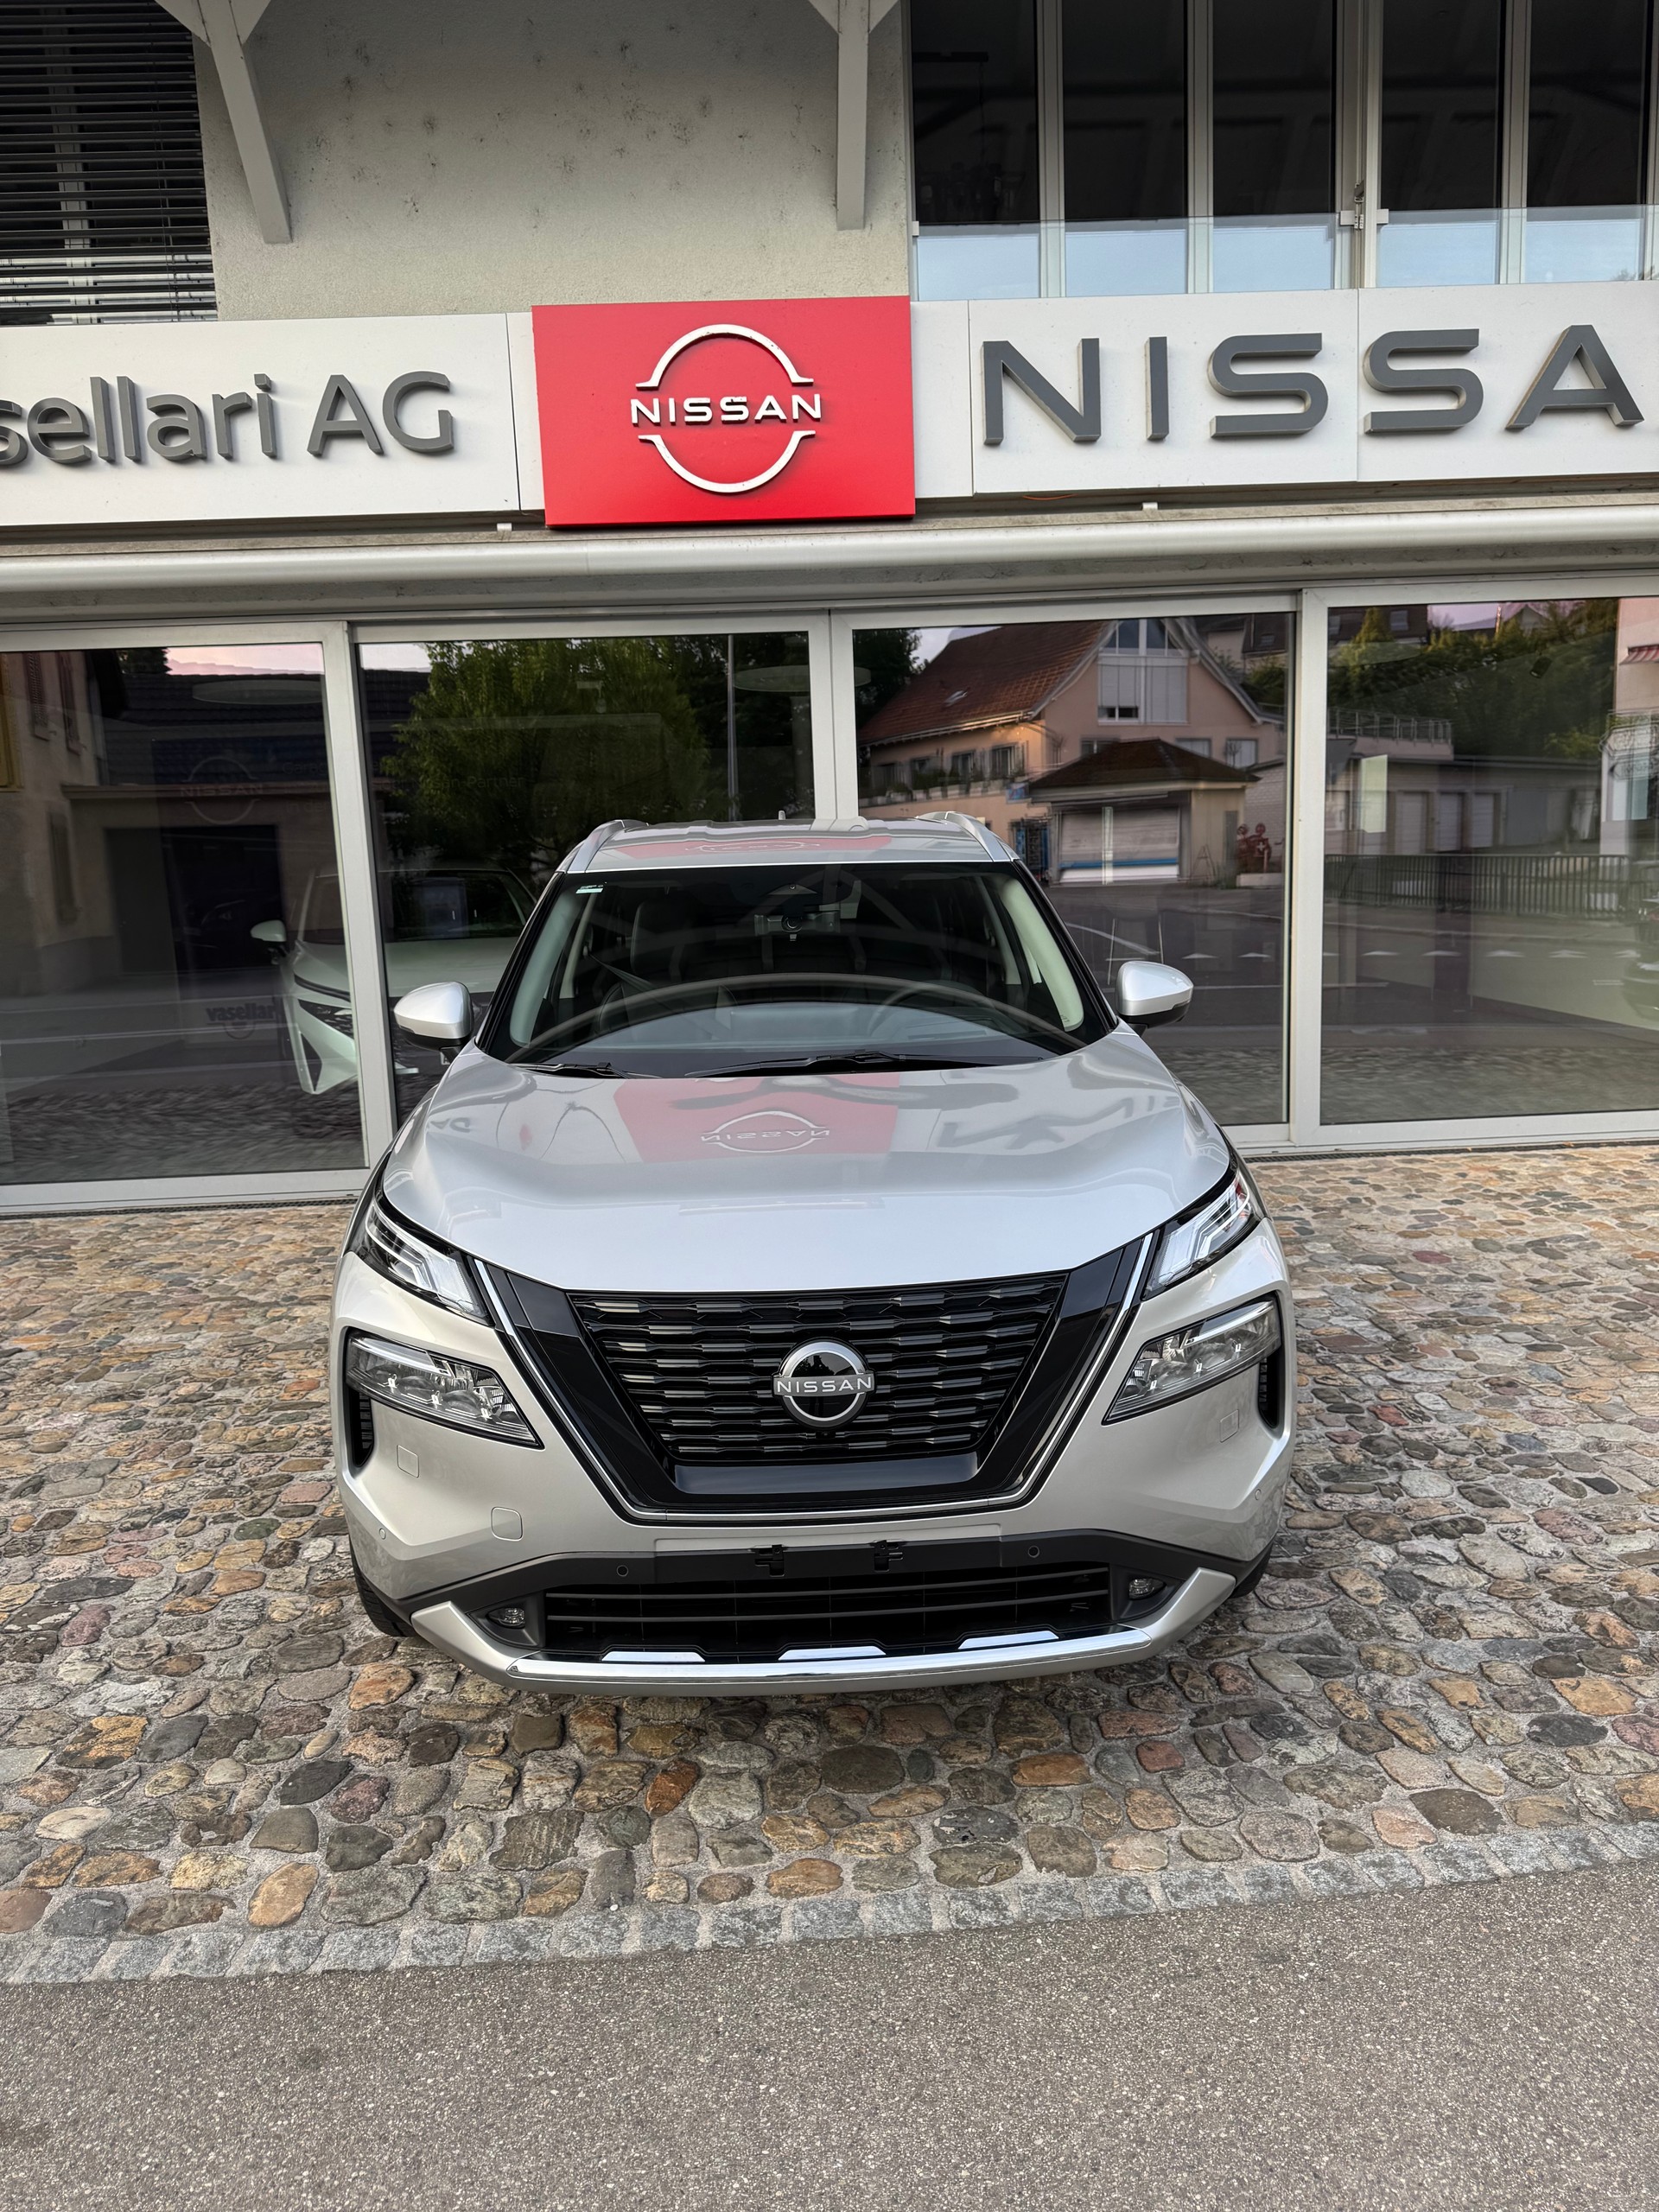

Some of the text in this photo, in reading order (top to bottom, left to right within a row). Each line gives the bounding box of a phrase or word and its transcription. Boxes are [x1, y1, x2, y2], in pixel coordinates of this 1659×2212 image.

[982, 324, 1645, 446] NISSA
[307, 371, 454, 457] AG
[631, 394, 822, 426] NISSAN
[180, 783, 264, 798] NISSAN
[206, 1002, 277, 1022] vasellar
[777, 1376, 872, 1394] NISSAN
